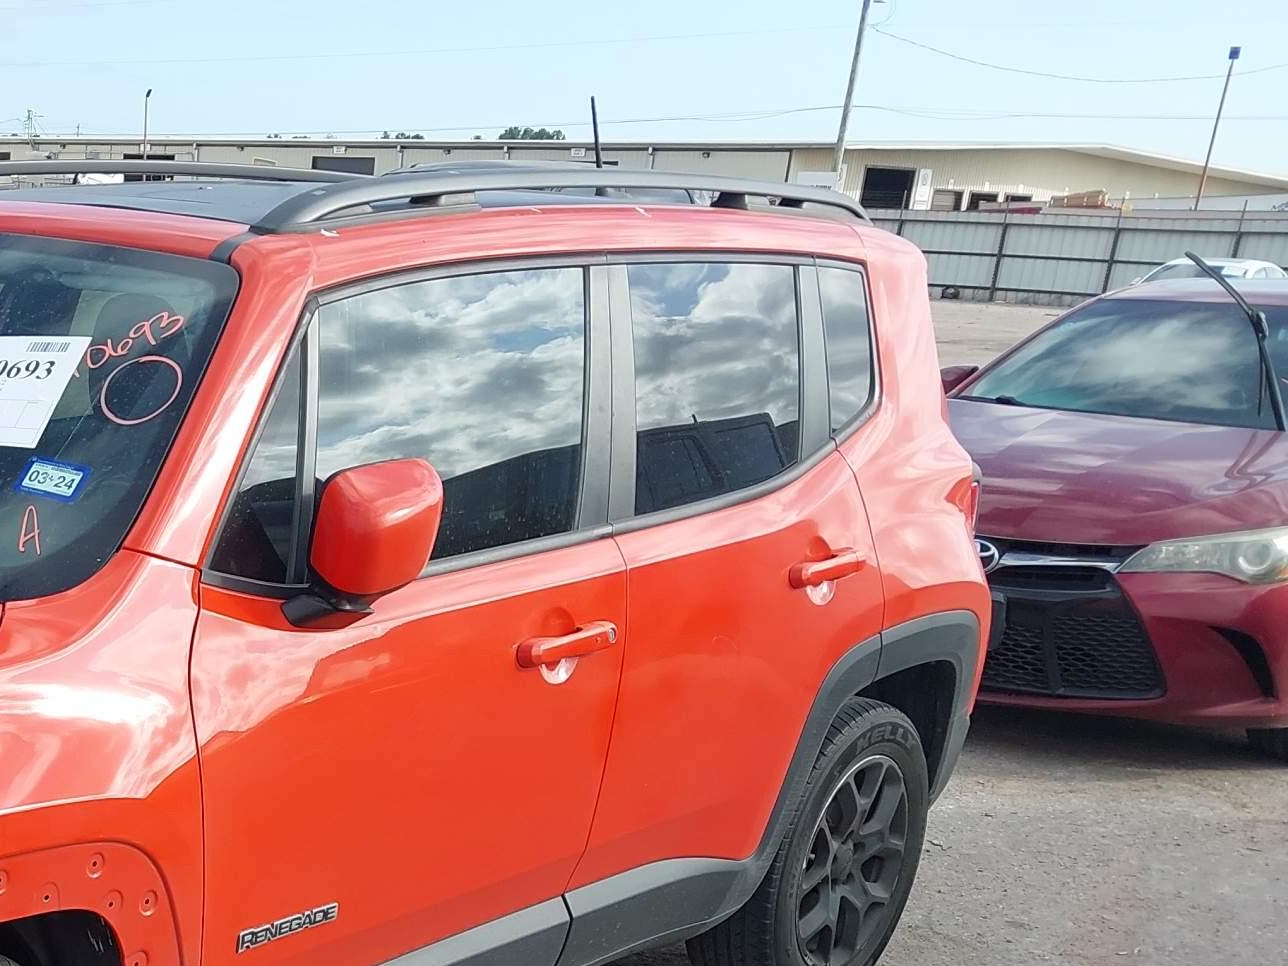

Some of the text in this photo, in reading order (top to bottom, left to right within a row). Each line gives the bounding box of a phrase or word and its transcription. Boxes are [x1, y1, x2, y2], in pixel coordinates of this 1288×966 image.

[73, 311, 185, 378] 0693
[28, 470, 49, 485] 03
[53, 475, 76, 491] 24
[17, 504, 41, 556] A
[856, 725, 918, 755] KELLY
[236, 902, 340, 953] RENEGADE
